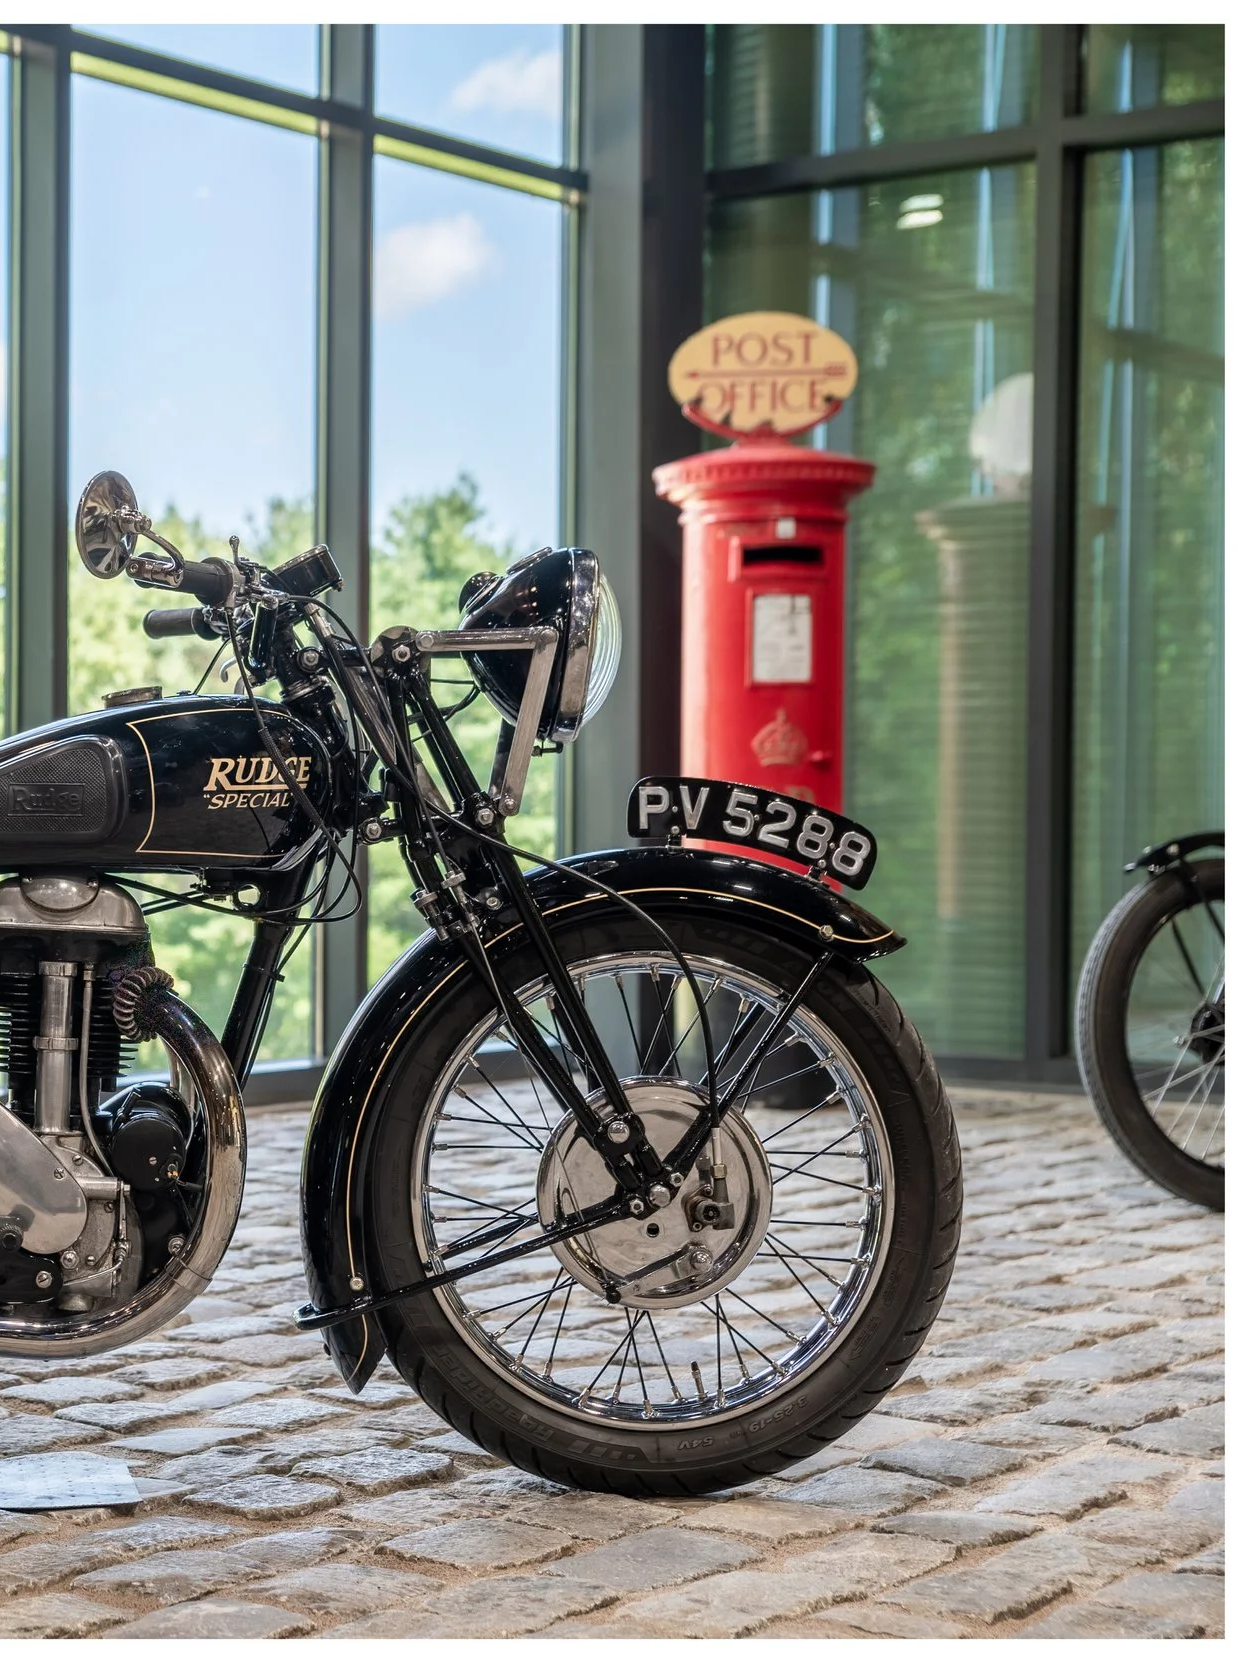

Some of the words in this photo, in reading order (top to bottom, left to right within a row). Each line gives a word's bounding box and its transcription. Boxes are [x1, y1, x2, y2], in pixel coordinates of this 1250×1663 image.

[713, 331, 818, 368] POST
[697, 378, 827, 414] OFFICE
[722, 789, 872, 877] 5288
[749, 1395, 808, 1434] 3.25-19
[678, 1436, 715, 1450] 54V
